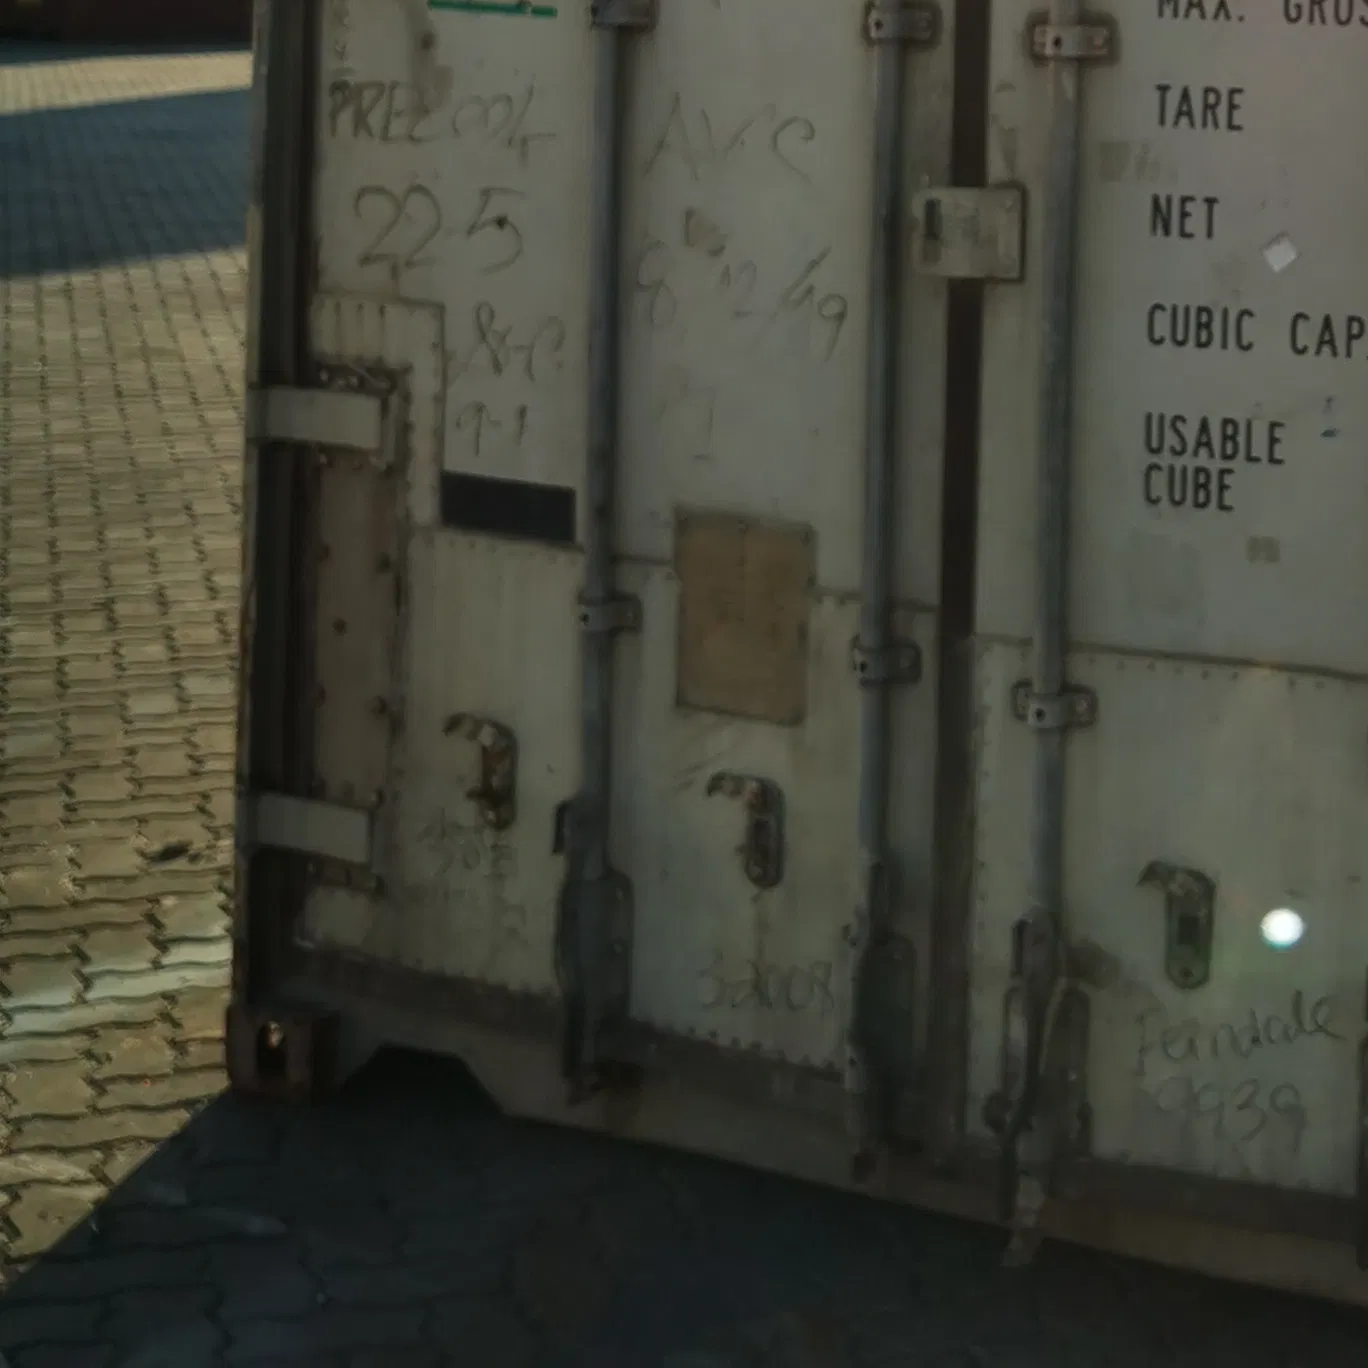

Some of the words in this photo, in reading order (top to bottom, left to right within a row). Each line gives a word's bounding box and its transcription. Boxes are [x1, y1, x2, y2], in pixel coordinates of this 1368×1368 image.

[1154, 83, 1245, 132] TARE
[1151, 193, 1220, 240] NET
[1146, 301, 1256, 352] CUBIC
[1143, 411, 1286, 465] USABLE
[1143, 461, 1236, 512] CUBE
